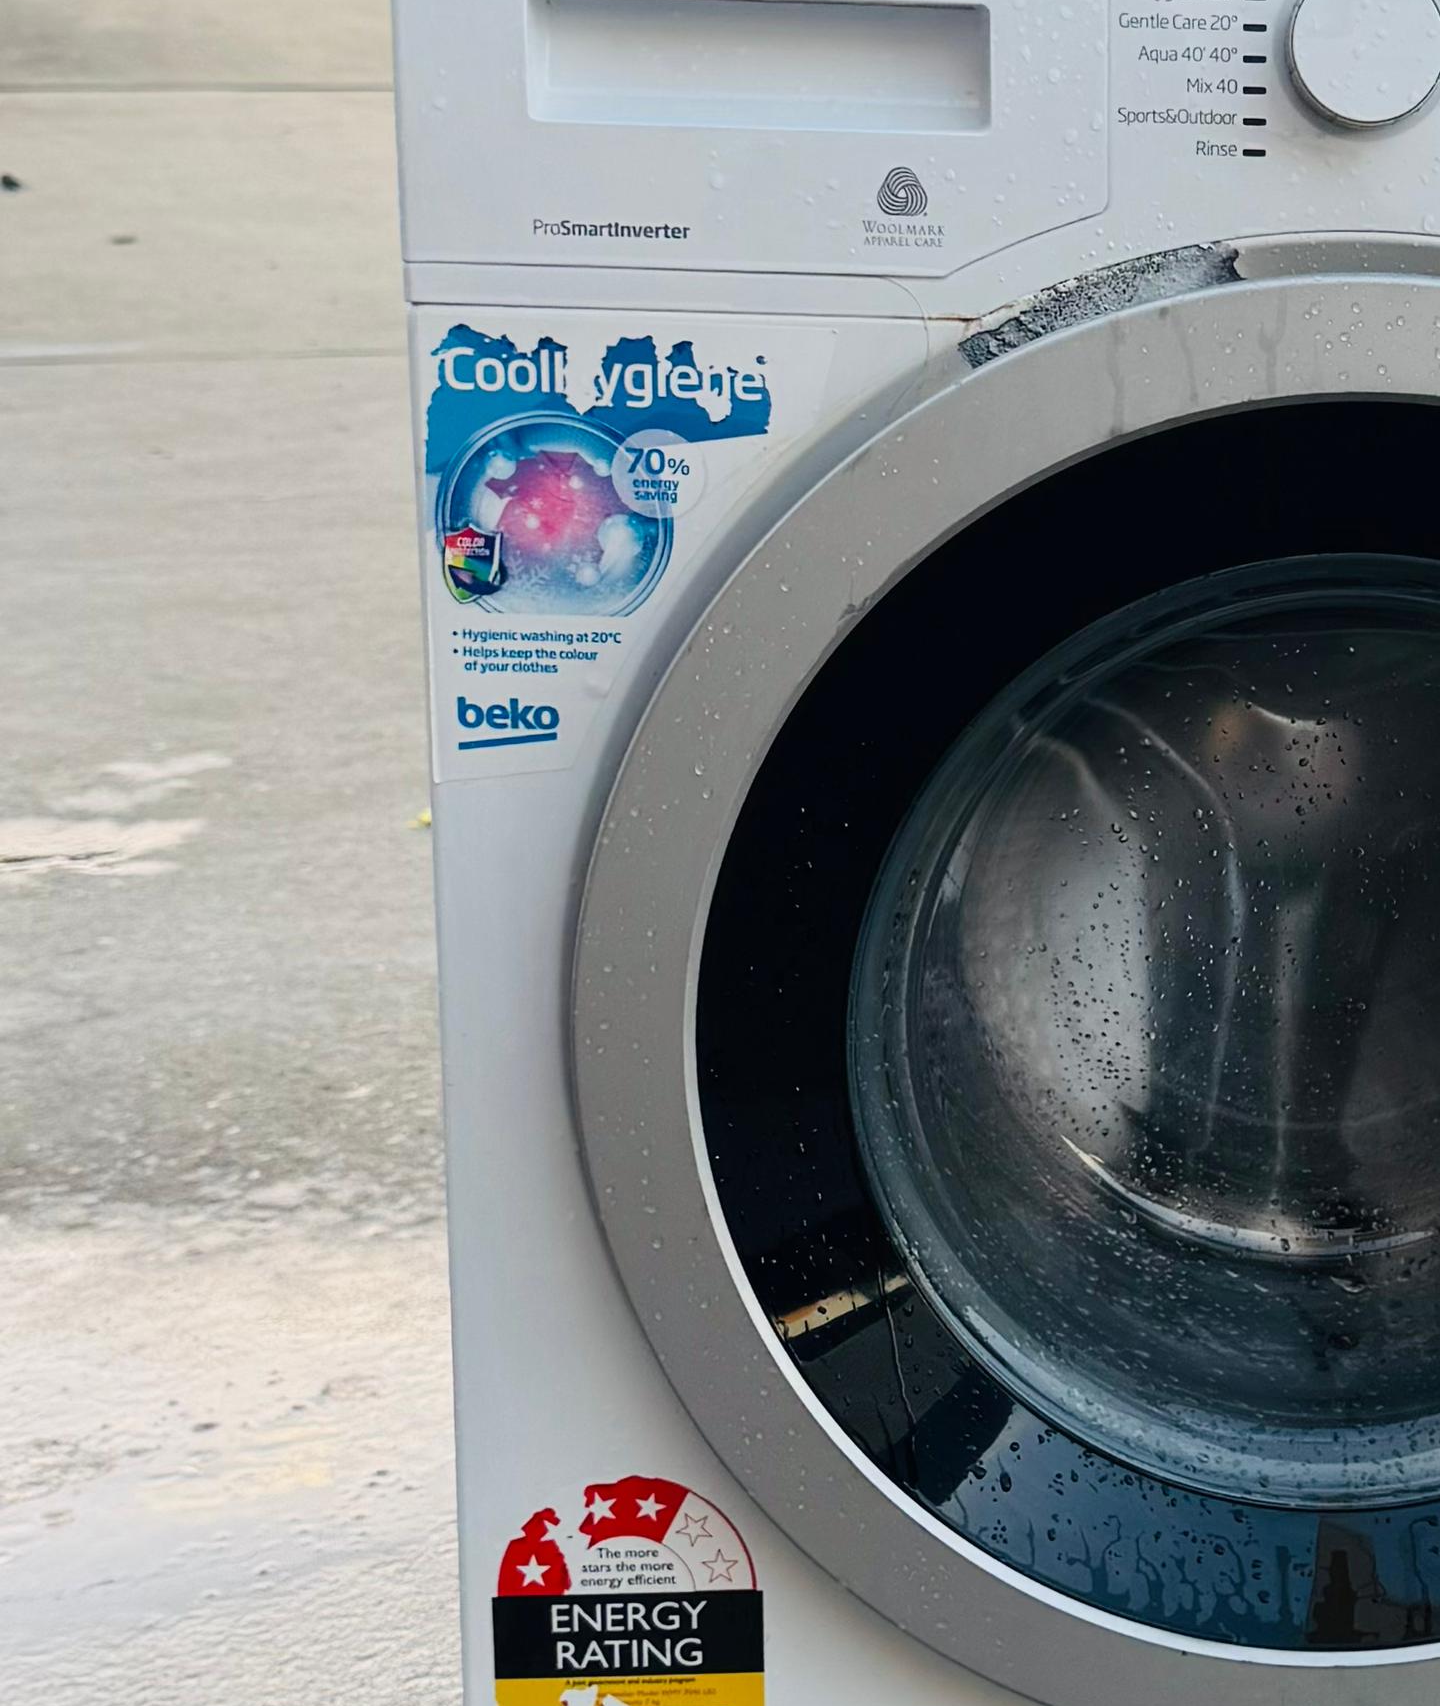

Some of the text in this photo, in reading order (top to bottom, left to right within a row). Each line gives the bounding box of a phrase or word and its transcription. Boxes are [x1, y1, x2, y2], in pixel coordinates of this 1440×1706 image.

[1119, 13, 1168, 31] Gentle
[1172, 14, 1207, 31] Care
[1138, 47, 1178, 66] Aqua
[1187, 78, 1237, 95] Mix 40
[1117, 108, 1237, 128] Sports&Outdoor
[1196, 142, 1237, 158] Rinse
[532, 219, 691, 242] ProSmartInverter
[862, 220, 945, 237] WOOLMARK
[914, 237, 944, 248] CARE
[625, 447, 690, 476] 70%
[632, 479, 679, 491] energy
[634, 491, 678, 503] saving
[462, 629, 517, 643] Hygienic
[520, 631, 573, 644] washing
[576, 632, 589, 642] at
[463, 646, 598, 661] Helps keep the colour
[464, 660, 558, 674] of your clothes
[457, 697, 560, 730] beko
[597, 1547, 659, 1558] The more
[582, 1561, 674, 1573] stars the more
[580, 1574, 677, 1589] energy efficient
[550, 1600, 708, 1634] ENERGY
[555, 1637, 704, 1670] RATING
